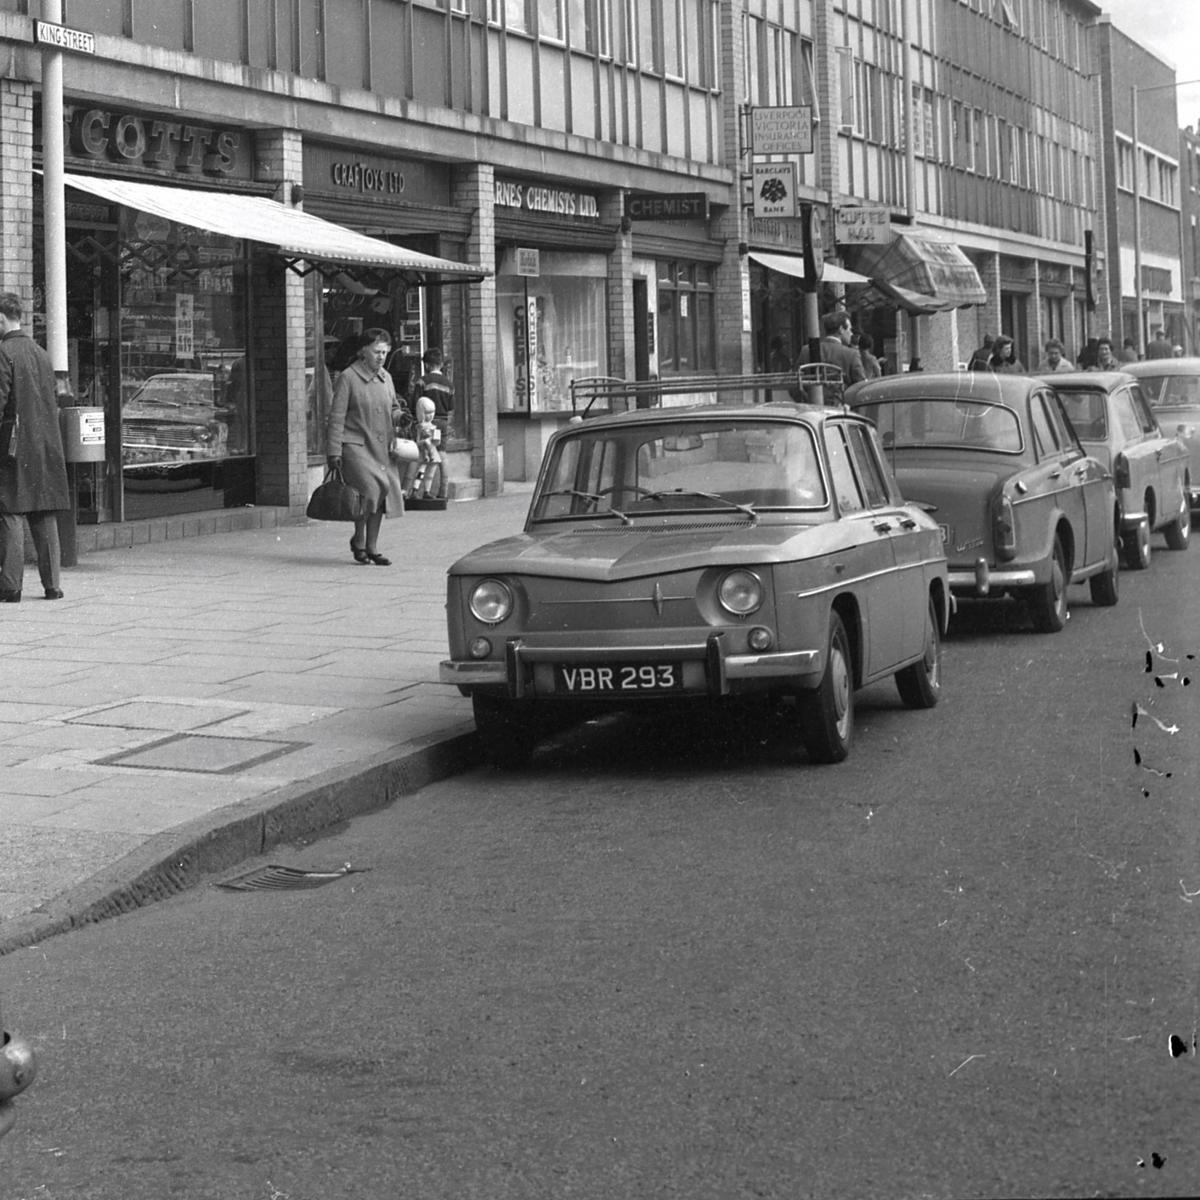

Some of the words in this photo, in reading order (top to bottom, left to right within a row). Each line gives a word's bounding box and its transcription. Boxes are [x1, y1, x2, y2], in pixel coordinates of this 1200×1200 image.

[40, 23, 61, 44] KING
[63, 29, 93, 51] STREET
[754, 121, 809, 131] VICTORIA
[333, 163, 385, 193] CRAFTOYS
[387, 171, 405, 193] LTD
[494, 181, 522, 208] RNES
[527, 187, 576, 215] CHEMISTS
[580, 194, 599, 218] LTD.
[630, 199, 700, 215] CHEMIST
[514, 304, 526, 407] CHEMIST
[563, 668, 613, 690] VBR
[622, 665, 675, 690] 293
